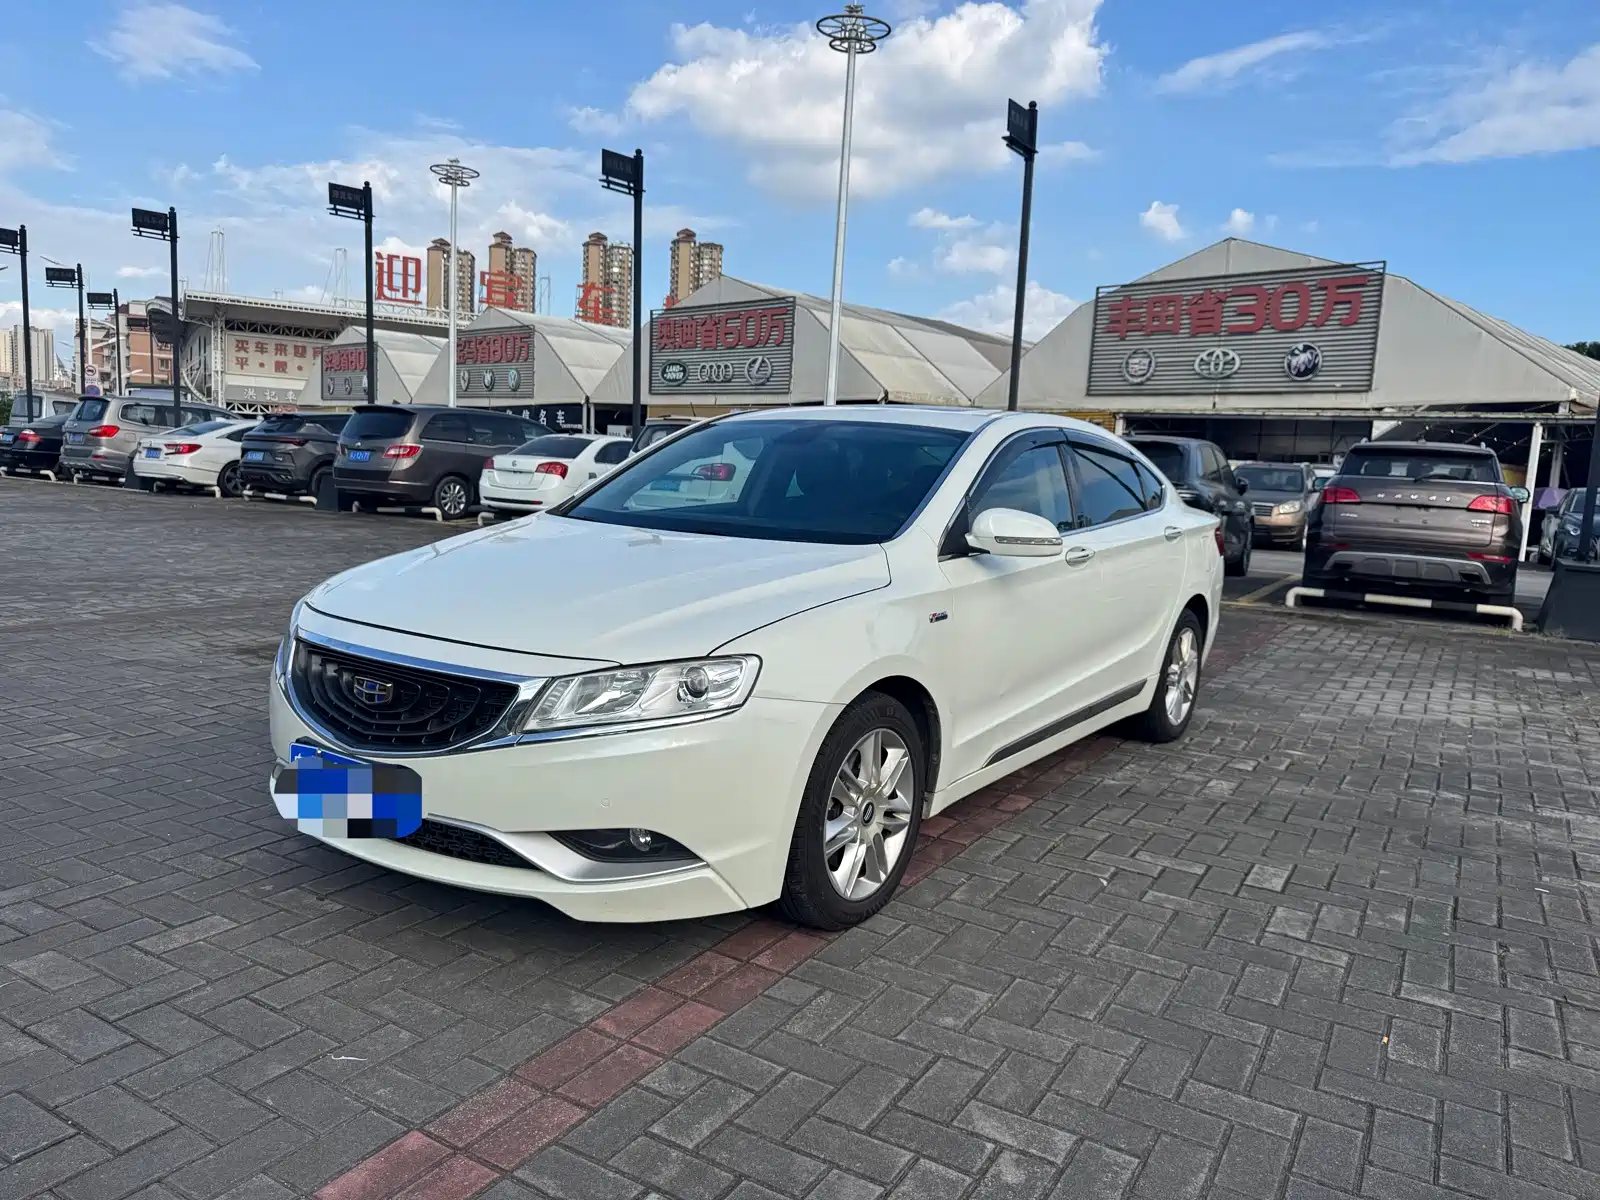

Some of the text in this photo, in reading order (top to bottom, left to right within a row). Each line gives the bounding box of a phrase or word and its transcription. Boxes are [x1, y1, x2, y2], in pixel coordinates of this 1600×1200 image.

[657, 307, 788, 350] 奥迪省60万
[1104, 276, 1369, 339] 丰田省30万
